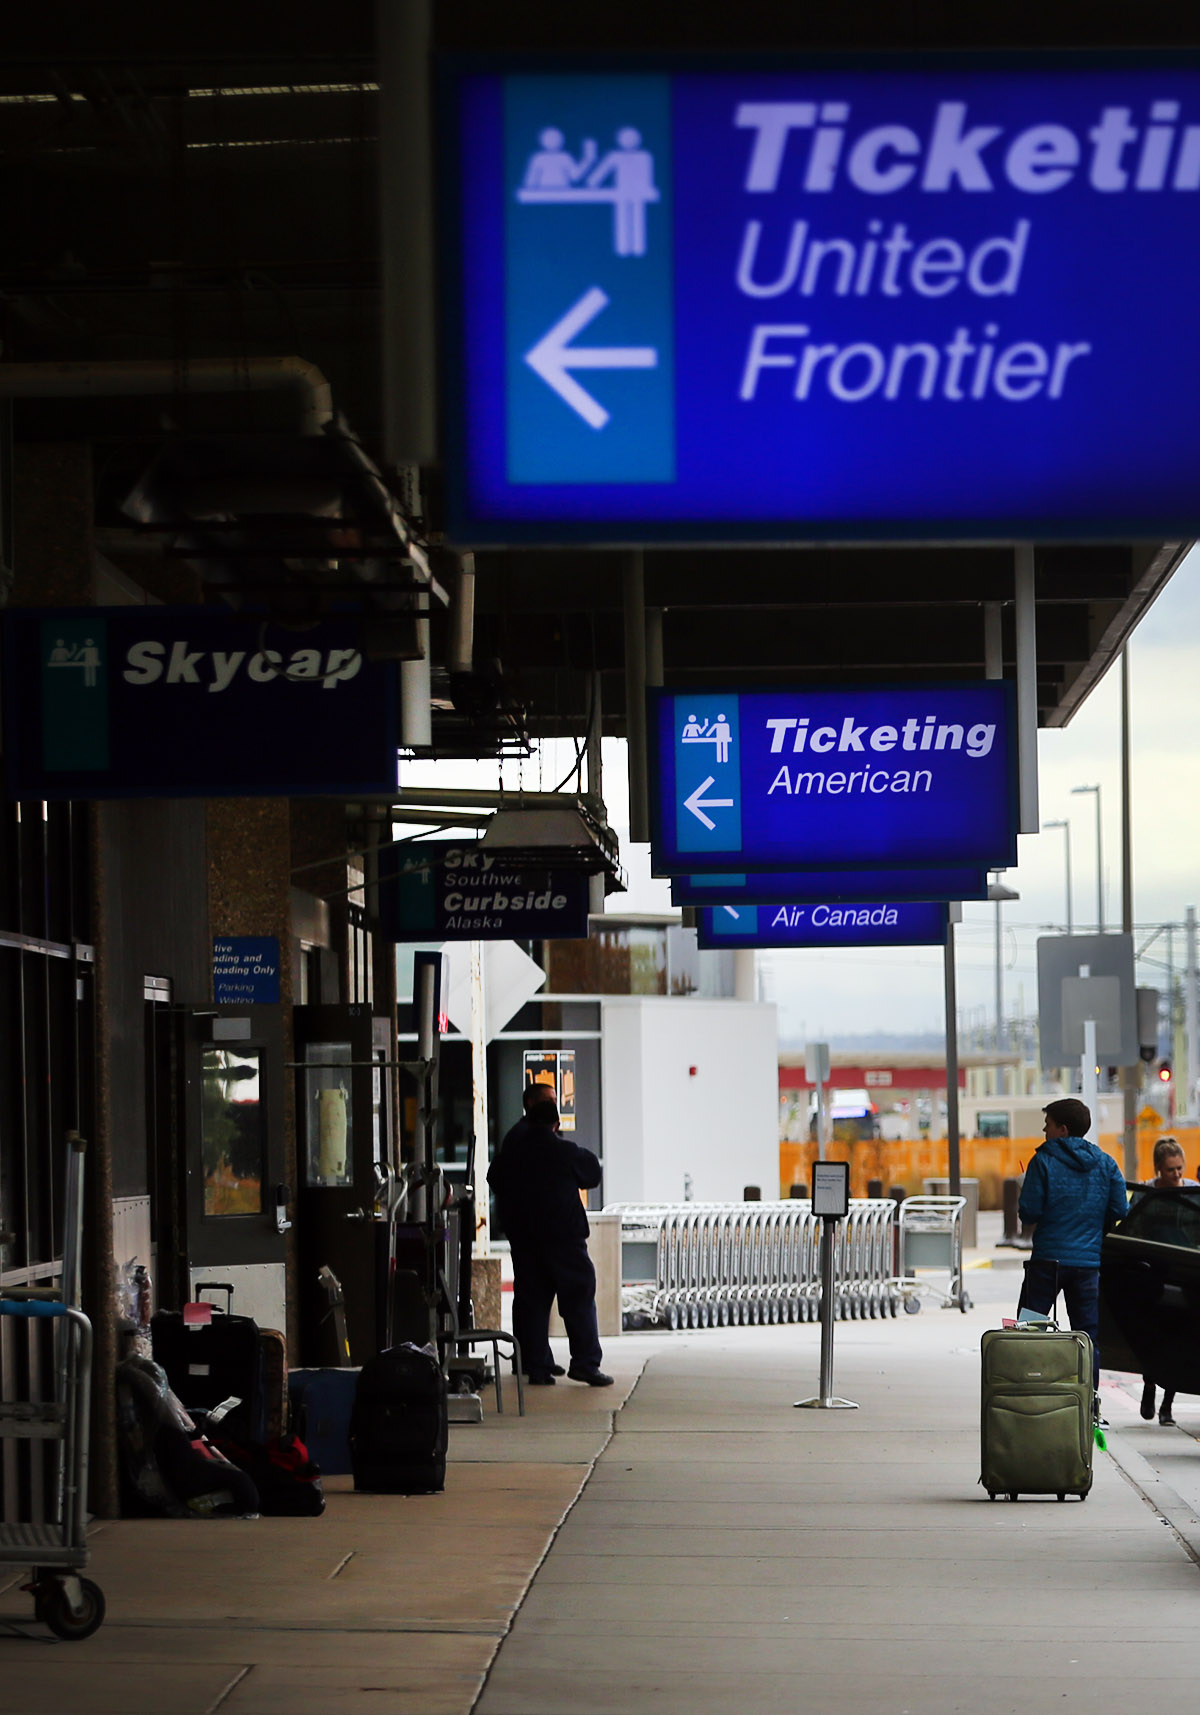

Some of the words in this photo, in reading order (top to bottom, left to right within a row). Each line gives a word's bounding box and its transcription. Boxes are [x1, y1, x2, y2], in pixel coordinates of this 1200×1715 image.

[735, 218, 1030, 298] United
[739, 323, 1091, 401] Frontier
[121, 640, 363, 694] Skycap
[766, 715, 997, 758] Ticketing
[767, 764, 933, 796] American
[444, 849, 495, 871] Sky
[444, 873, 521, 886] Southwe
[444, 891, 567, 911] Curbside
[445, 916, 503, 929] Alaska
[771, 906, 804, 928] Air
[811, 903, 899, 928] Canada
[213, 954, 239, 963] ading
[243, 954, 263, 962] and
[214, 944, 232, 952] tive
[213, 966, 250, 976] loading
[253, 965, 276, 976] Only
[218, 983, 255, 993] Parking
